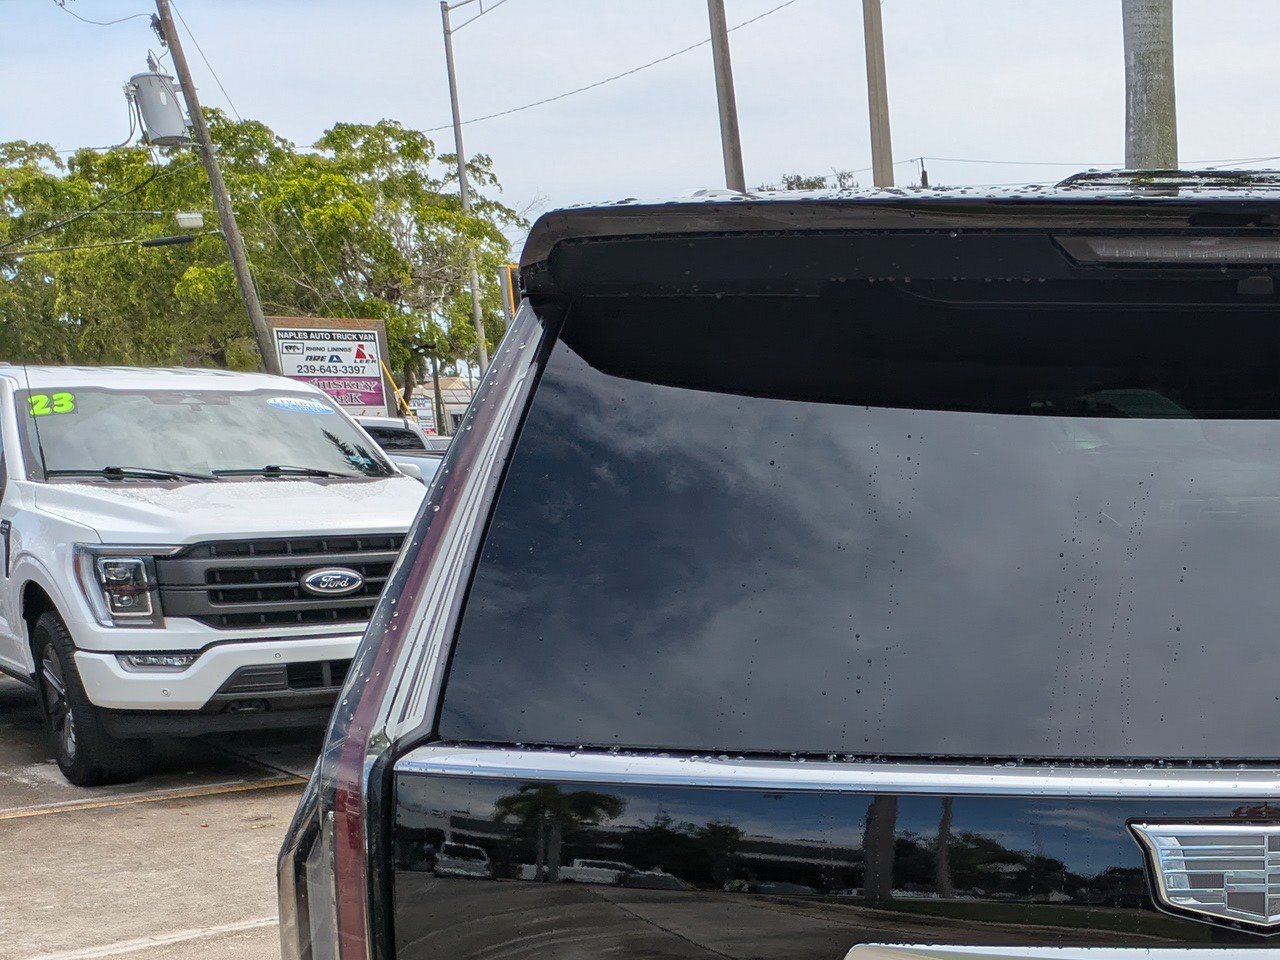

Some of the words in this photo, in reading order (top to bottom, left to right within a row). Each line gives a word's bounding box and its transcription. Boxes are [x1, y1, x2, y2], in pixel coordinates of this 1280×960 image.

[278, 331, 308, 339] NAPLES
[309, 332, 331, 340] AUTO
[358, 333, 374, 341] VAN
[297, 364, 366, 375] 239-643-3397
[311, 378, 378, 393] HISKEY
[28, 392, 75, 416] 23
[320, 575, 350, 588] Ford
